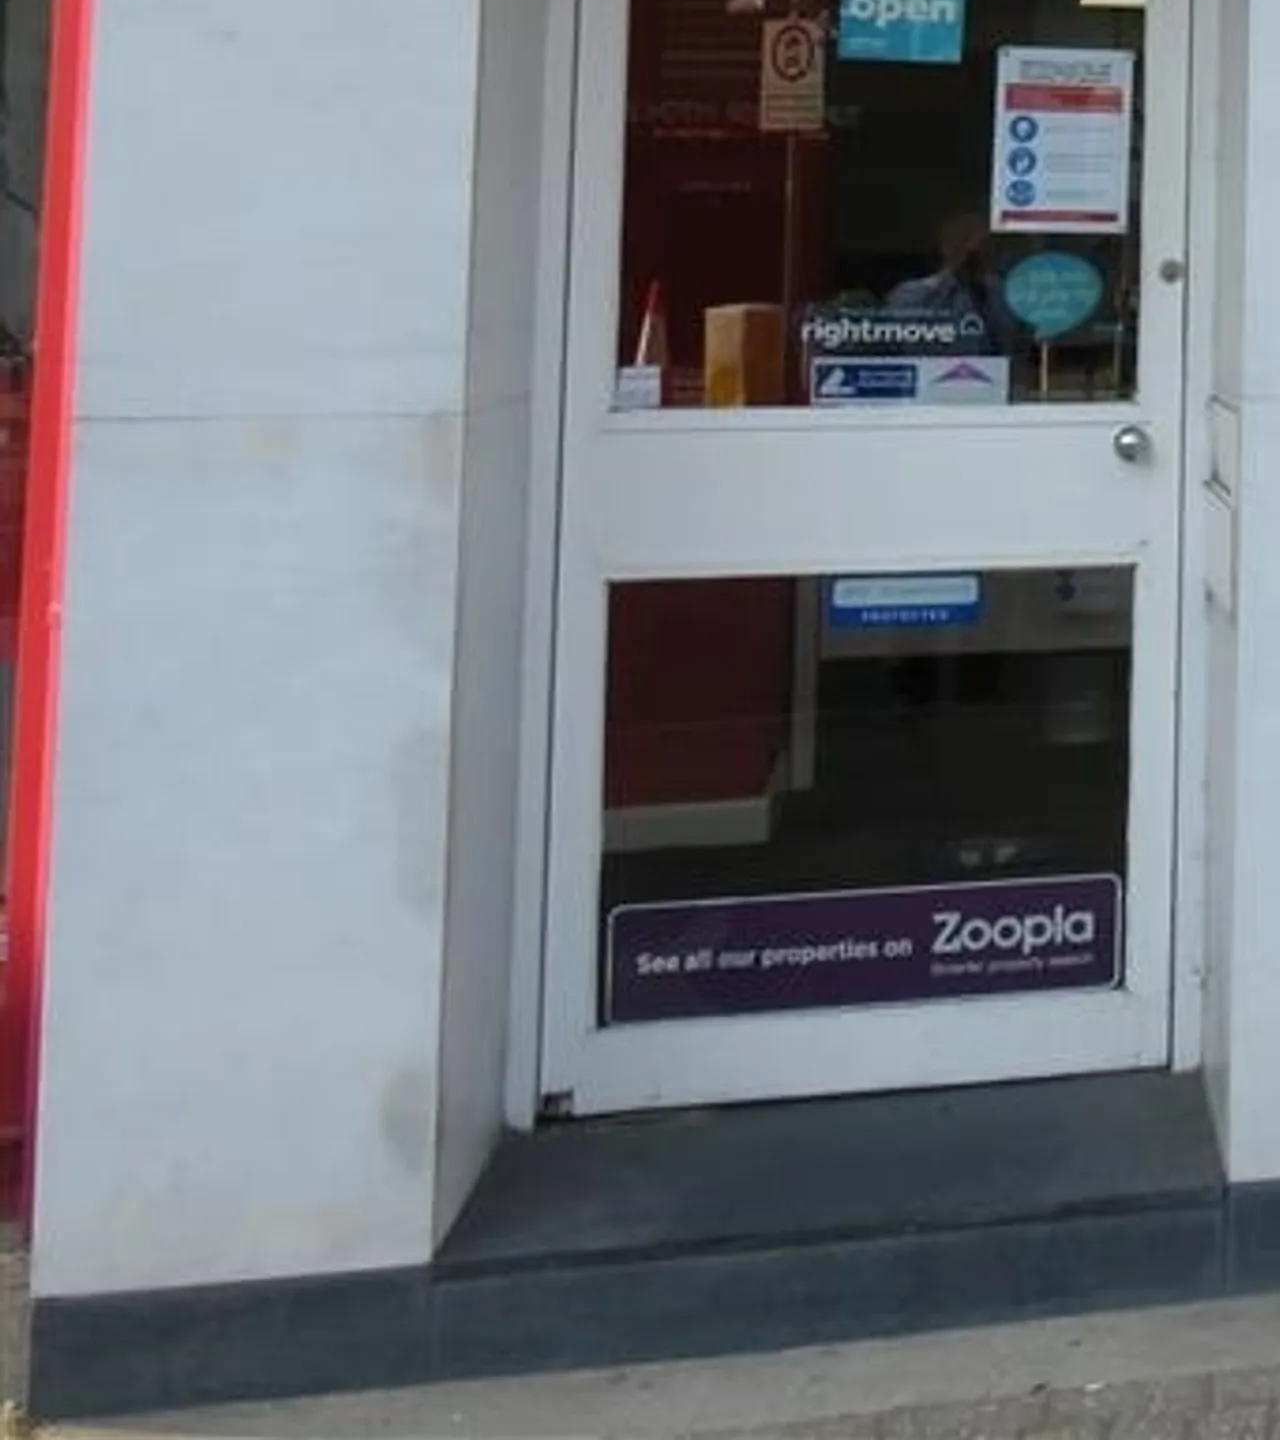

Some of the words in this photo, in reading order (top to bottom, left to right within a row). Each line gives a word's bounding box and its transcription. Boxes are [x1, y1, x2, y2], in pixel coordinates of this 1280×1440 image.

[800, 316, 957, 349] rightmove
[636, 951, 680, 976] See
[760, 938, 879, 970] properties
[881, 938, 913, 959] on
[932, 905, 1095, 956] Zoopla
